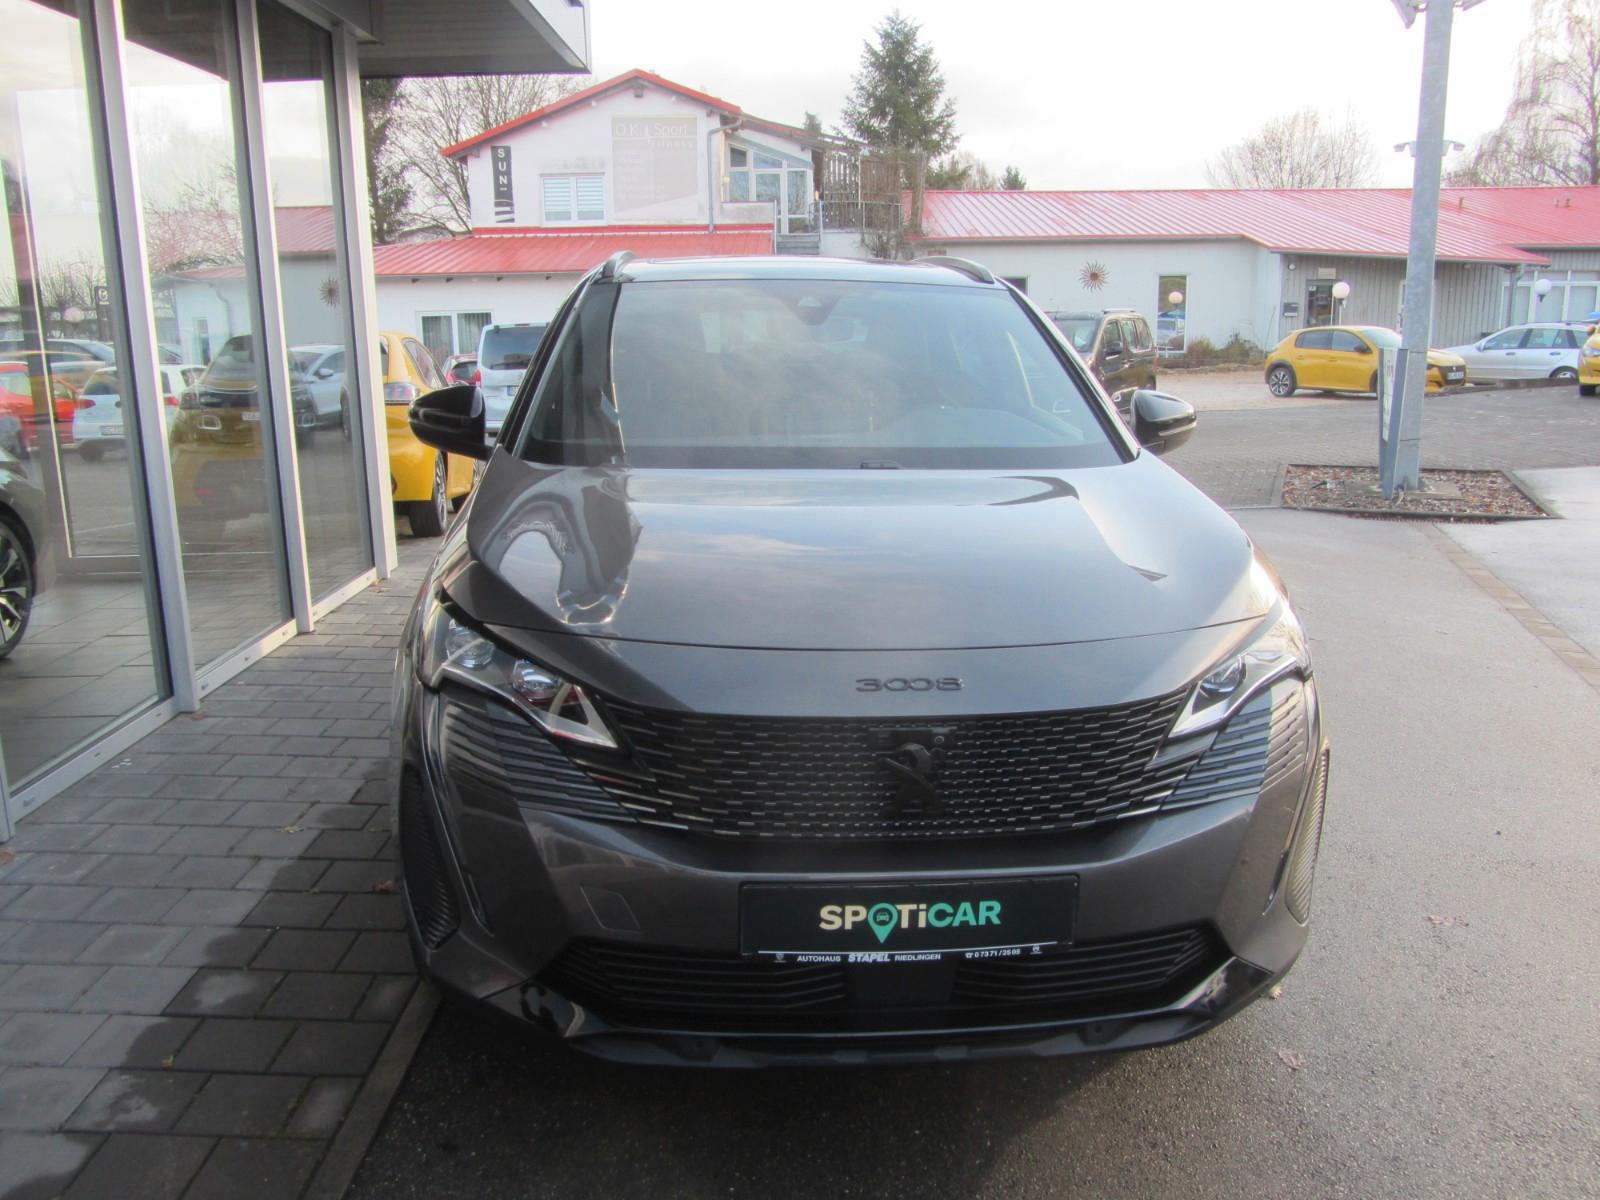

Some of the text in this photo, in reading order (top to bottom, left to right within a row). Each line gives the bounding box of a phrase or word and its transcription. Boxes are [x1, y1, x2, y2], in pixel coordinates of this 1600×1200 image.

[855, 677, 964, 692] 3008
[797, 954, 842, 963] AUTOHAUS
[847, 951, 891, 963] STAPEL
[894, 953, 941, 962] RIEDLINGEN
